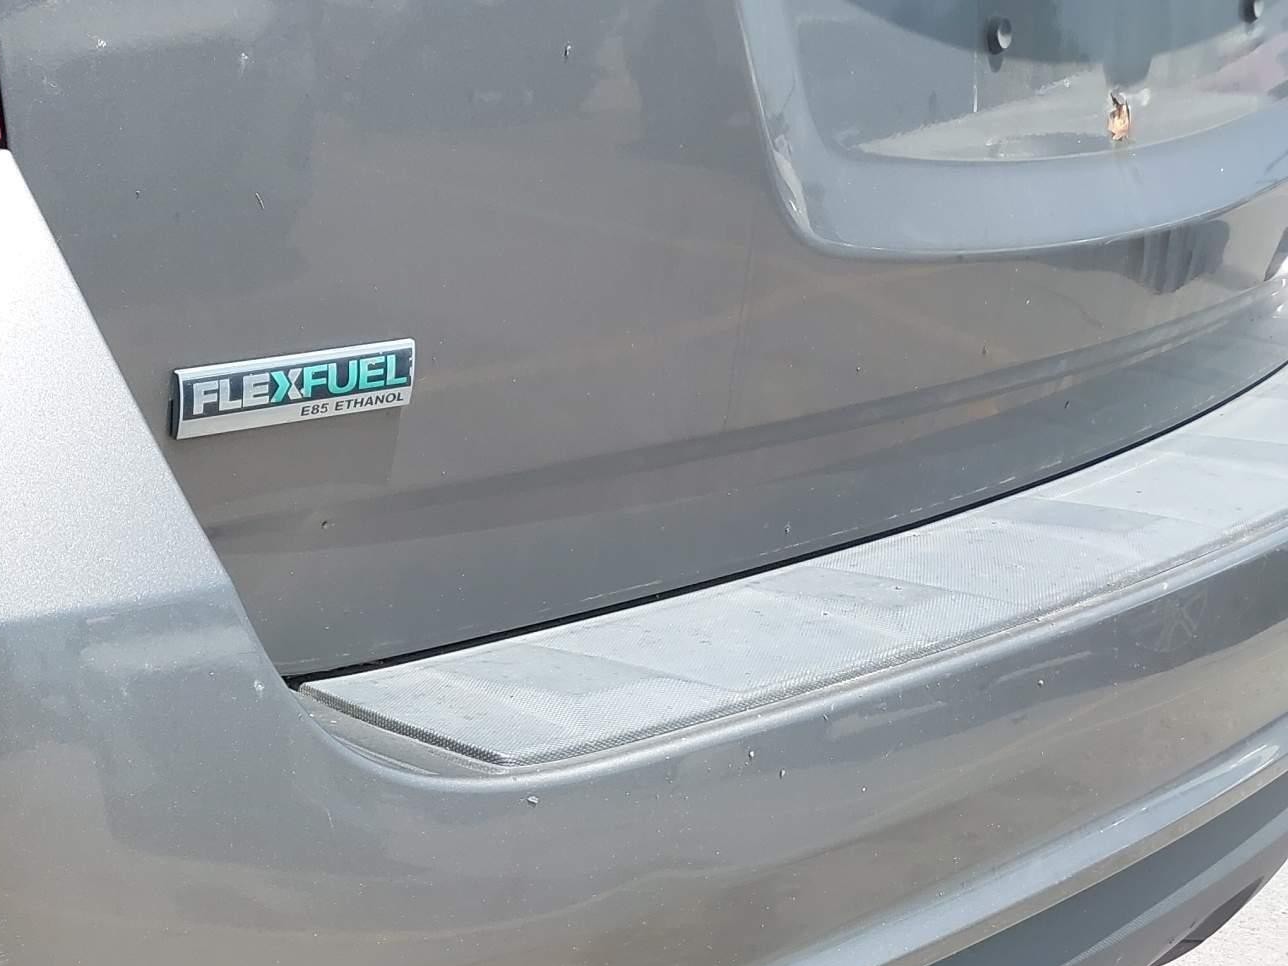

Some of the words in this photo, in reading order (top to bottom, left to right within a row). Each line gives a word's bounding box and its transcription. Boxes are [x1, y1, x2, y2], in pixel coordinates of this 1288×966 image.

[192, 354, 408, 416] FLEXFUEL
[300, 402, 330, 417] E85
[334, 391, 404, 411] ETHANOL
